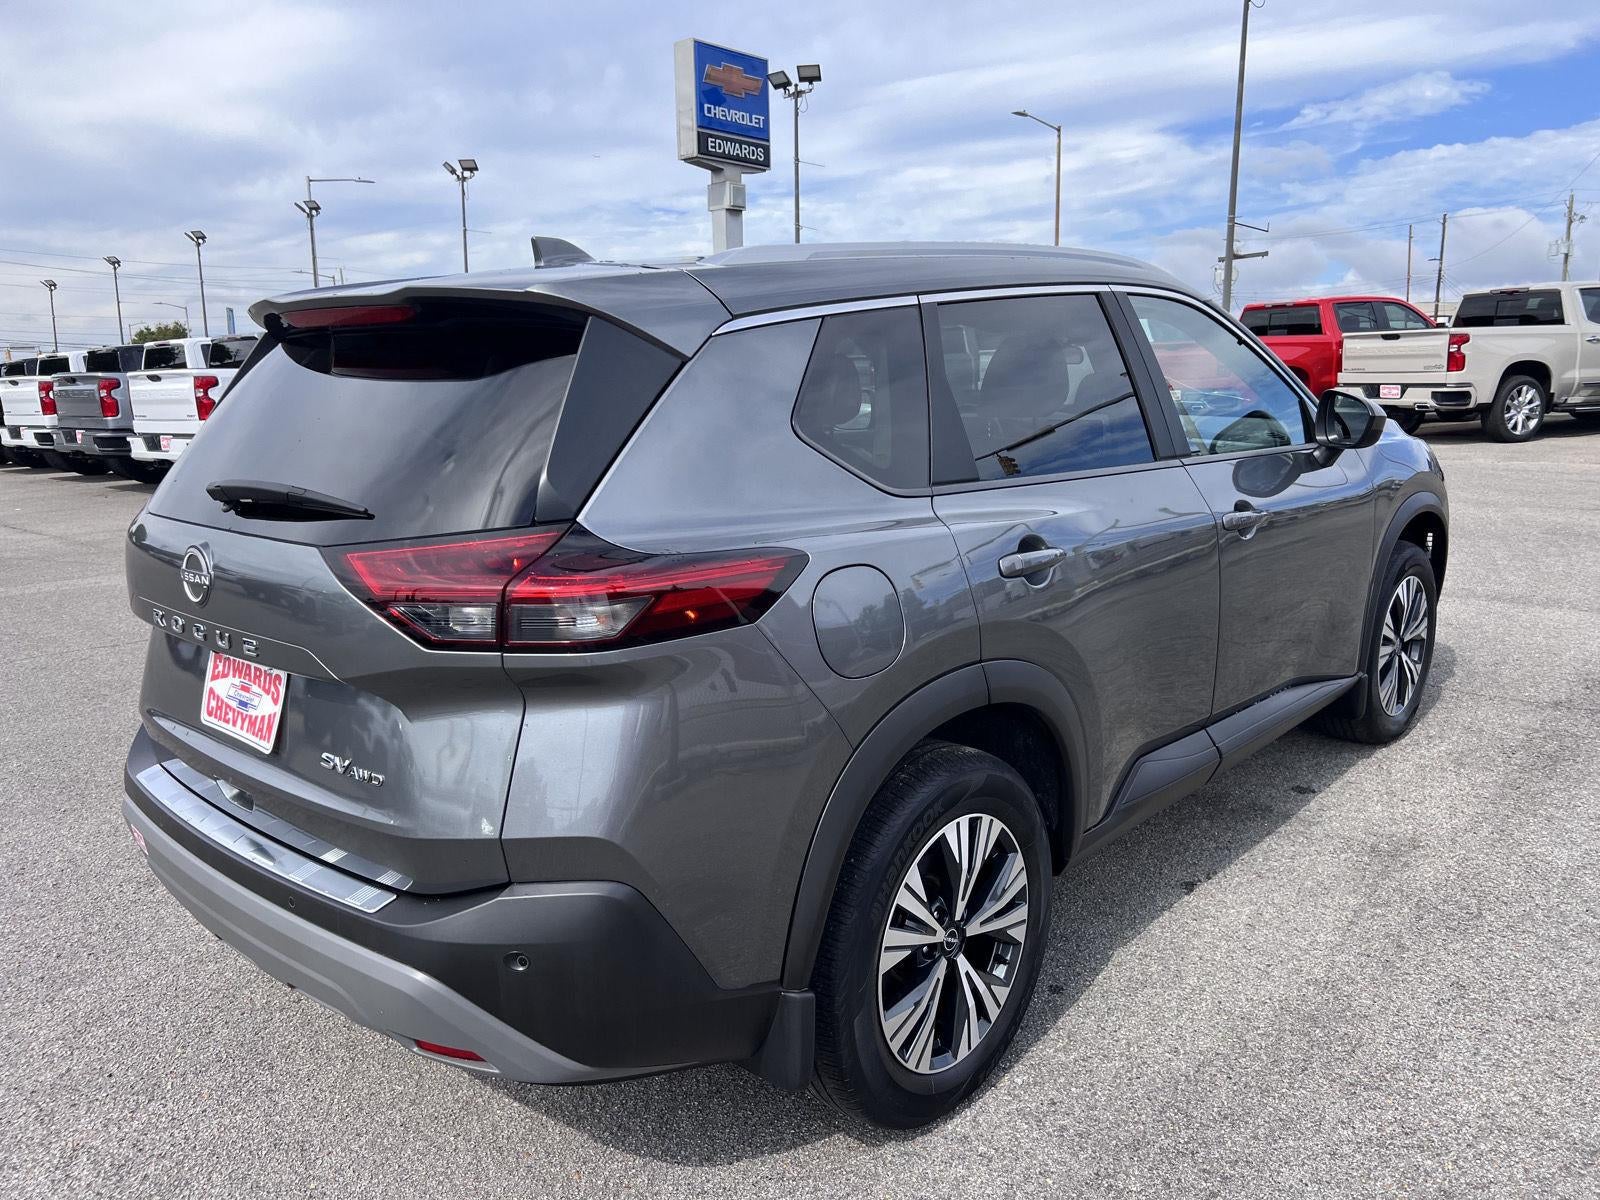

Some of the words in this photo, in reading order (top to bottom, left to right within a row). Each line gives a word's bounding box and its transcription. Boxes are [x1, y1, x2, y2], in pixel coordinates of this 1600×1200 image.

[703, 104, 765, 129] CHEVROLET
[707, 137, 765, 161] EDWARDS
[152, 608, 260, 657] ROGUE
[210, 652, 283, 706] EDWARDS
[206, 686, 277, 744] CHEVYMAN
[320, 752, 352, 774] SV
[347, 766, 386, 788] AWD
